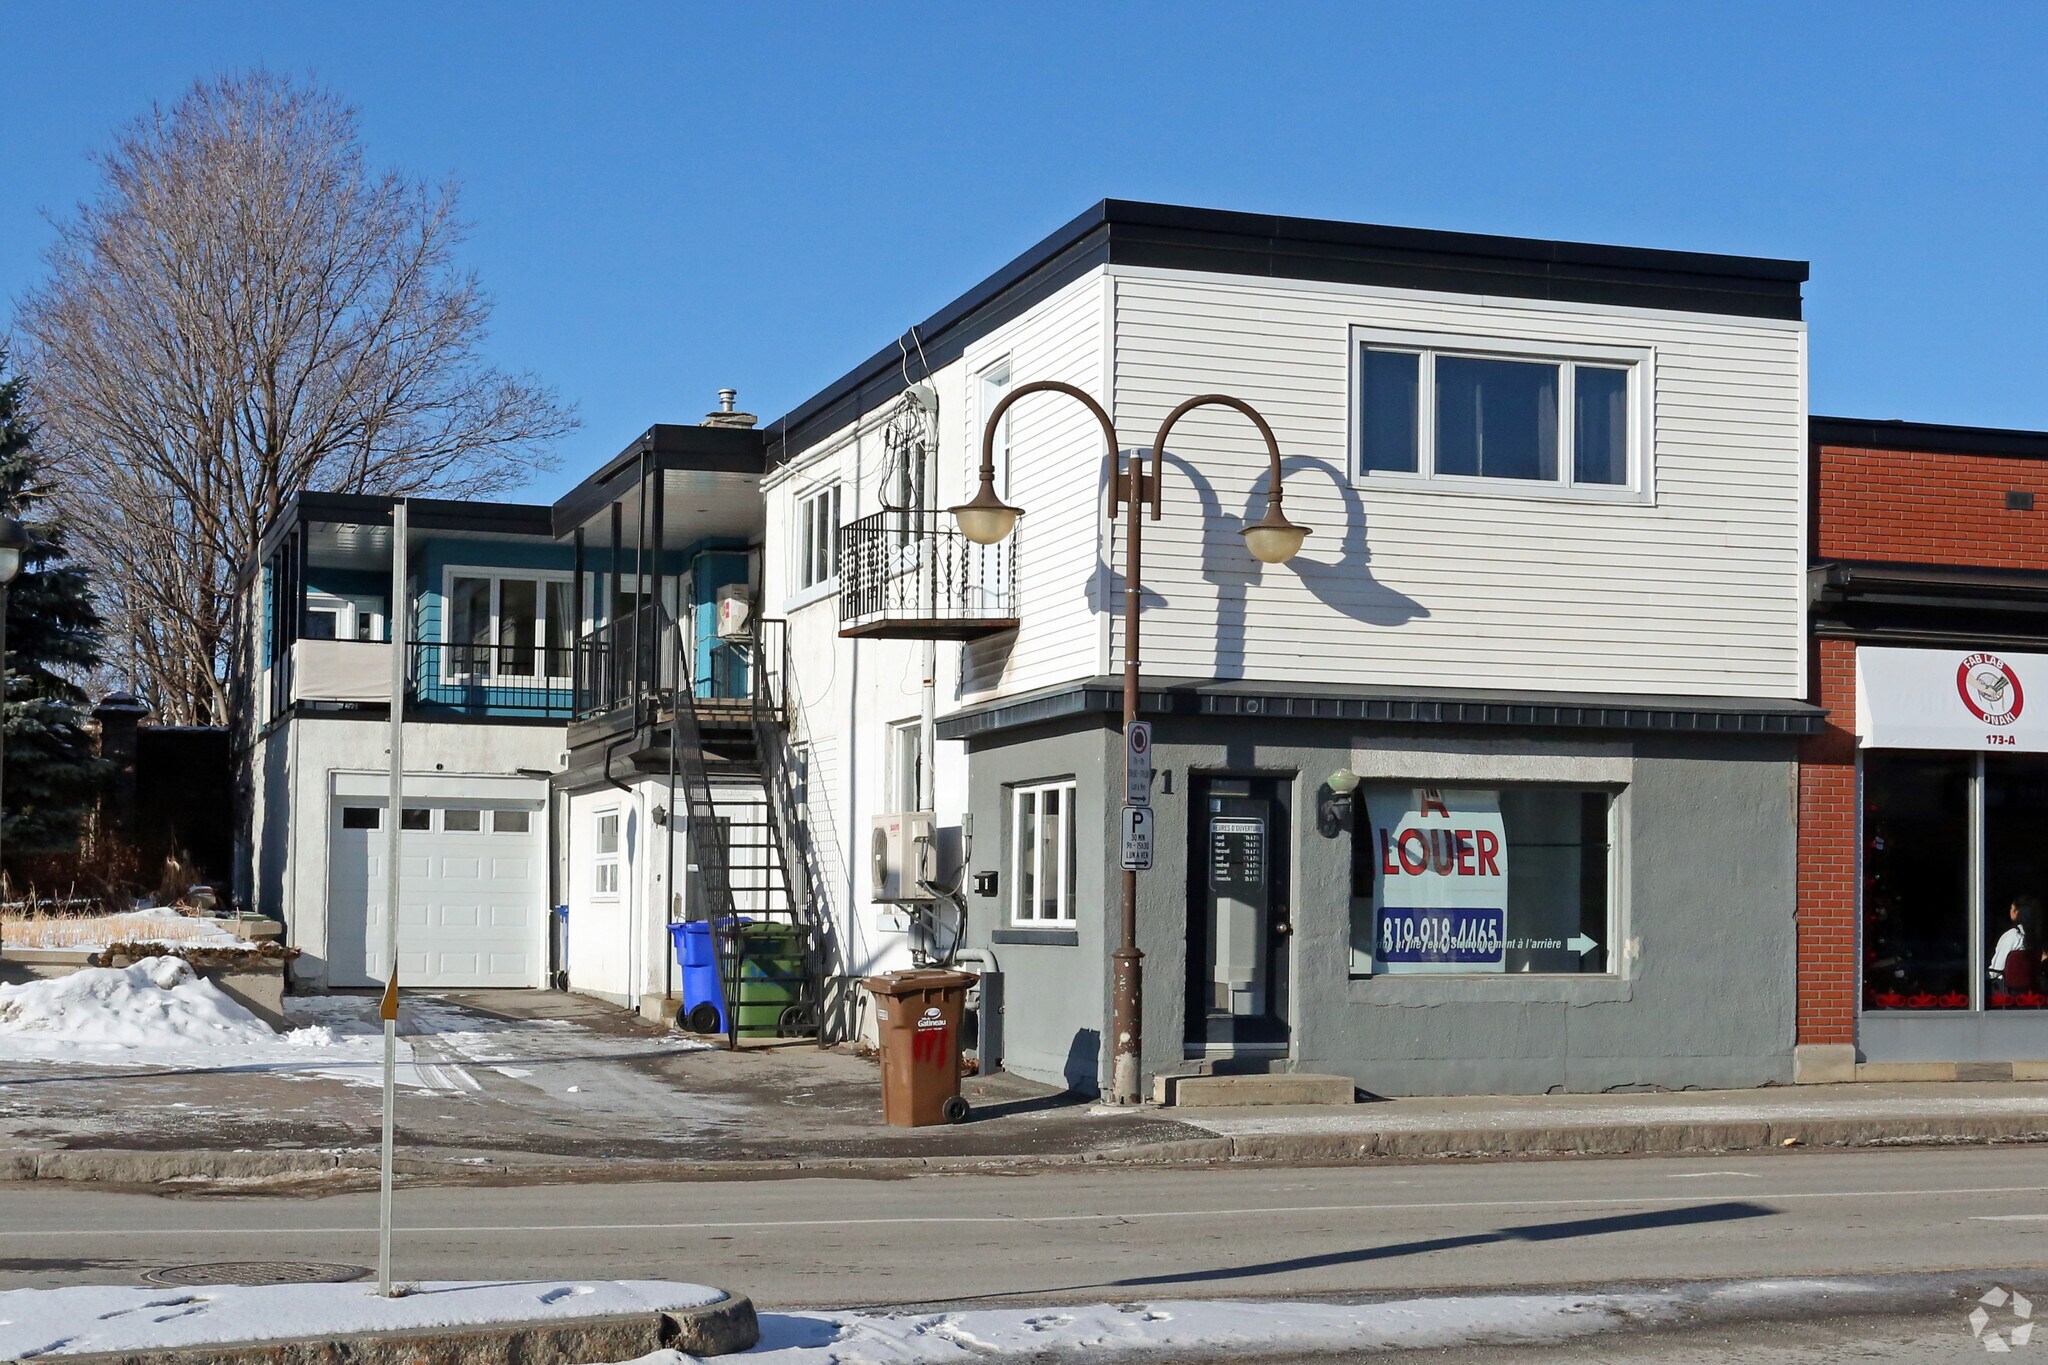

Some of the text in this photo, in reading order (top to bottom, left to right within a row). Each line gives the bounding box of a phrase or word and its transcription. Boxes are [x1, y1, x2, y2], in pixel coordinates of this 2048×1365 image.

[1963, 653, 2004, 670] FAB LAB
[1983, 712, 2016, 726] ONAKI
[1986, 734, 2016, 745] 173-A
[1132, 811, 1144, 833] P
[1380, 828, 1500, 876] LOUER
[1383, 917, 1497, 954] 819-918-4465
[918, 1019, 947, 1027] Gatineau
